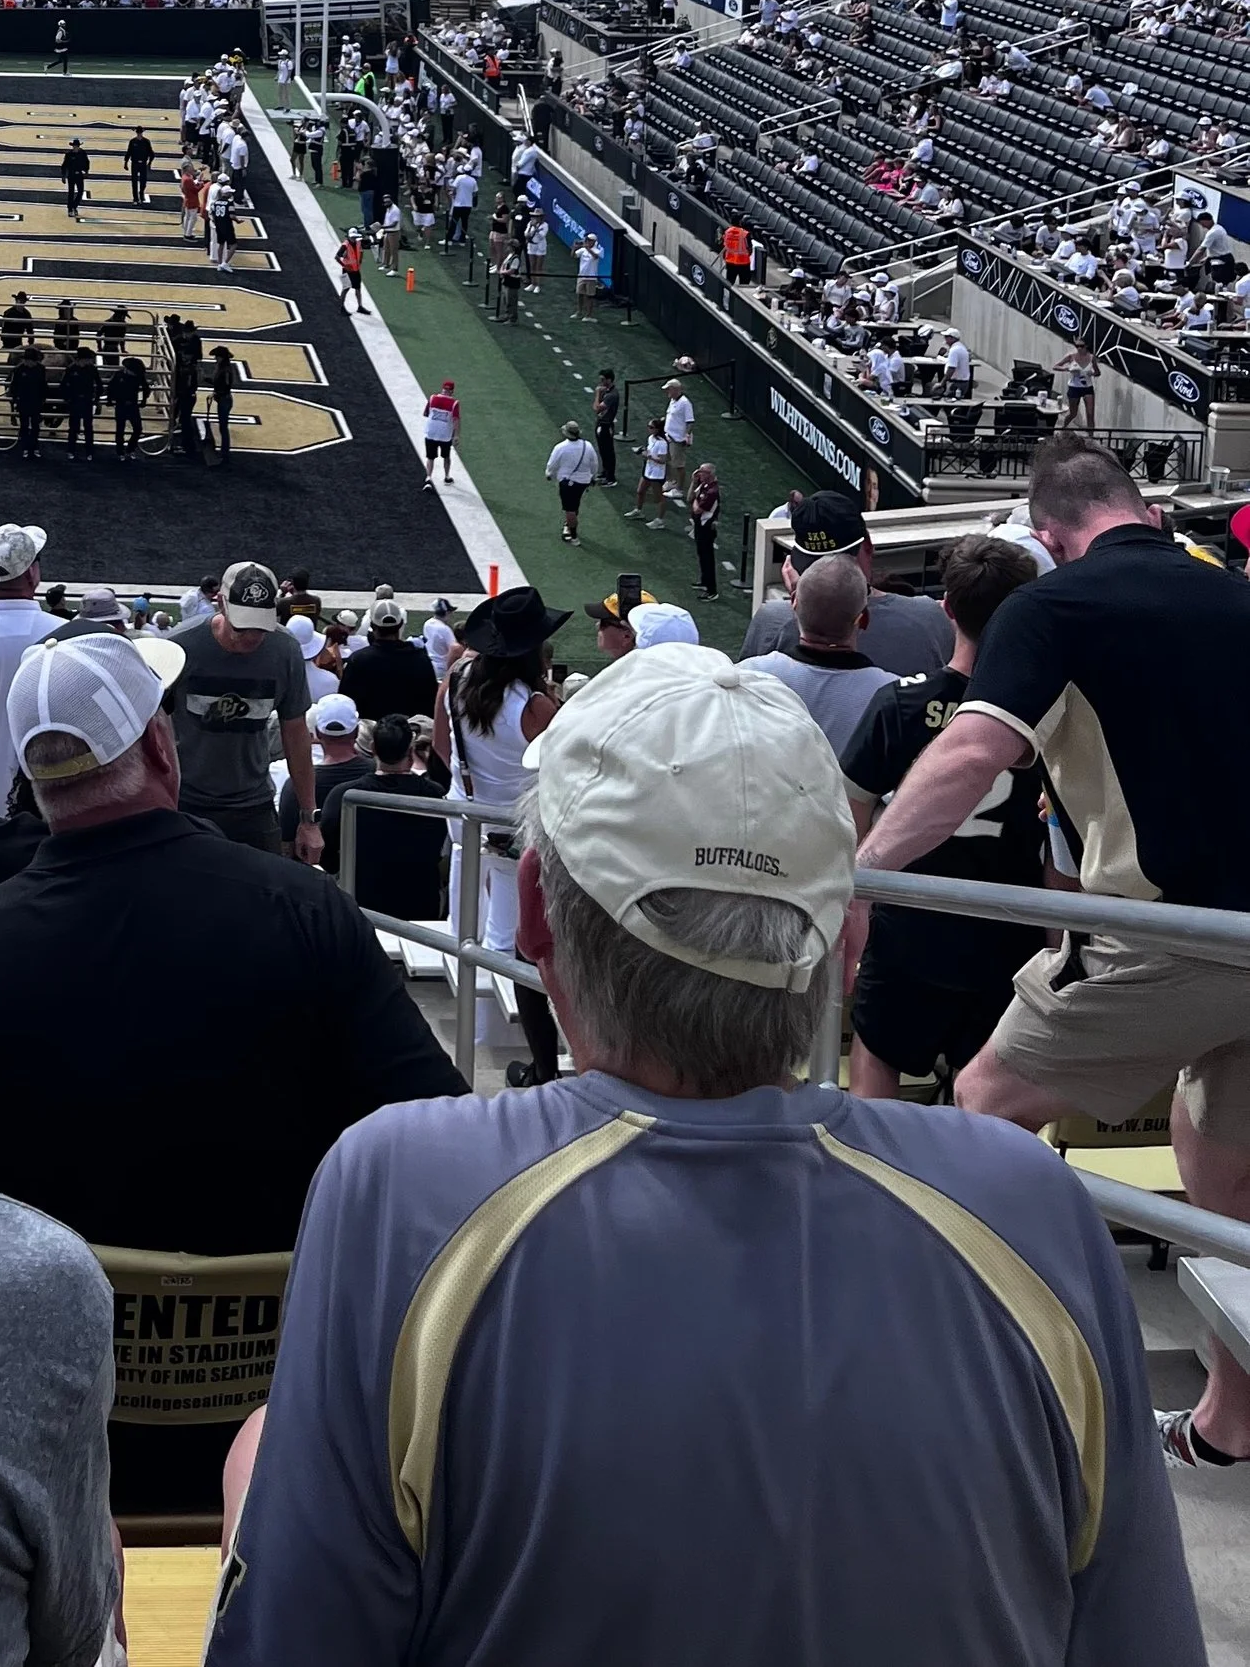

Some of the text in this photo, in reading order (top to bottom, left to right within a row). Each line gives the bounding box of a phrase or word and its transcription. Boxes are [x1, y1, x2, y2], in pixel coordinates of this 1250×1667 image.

[215, 205, 226, 217] 89
[1171, 373, 1197, 401] Ford
[770, 386, 862, 492] WILHITEWINS.COM
[695, 847, 781, 877] BUFFALOES
[138, 1346, 163, 1364] IN
[169, 1338, 276, 1364] STADIUM
[150, 1369, 171, 1384] OF
[174, 1367, 206, 1384] IMG
